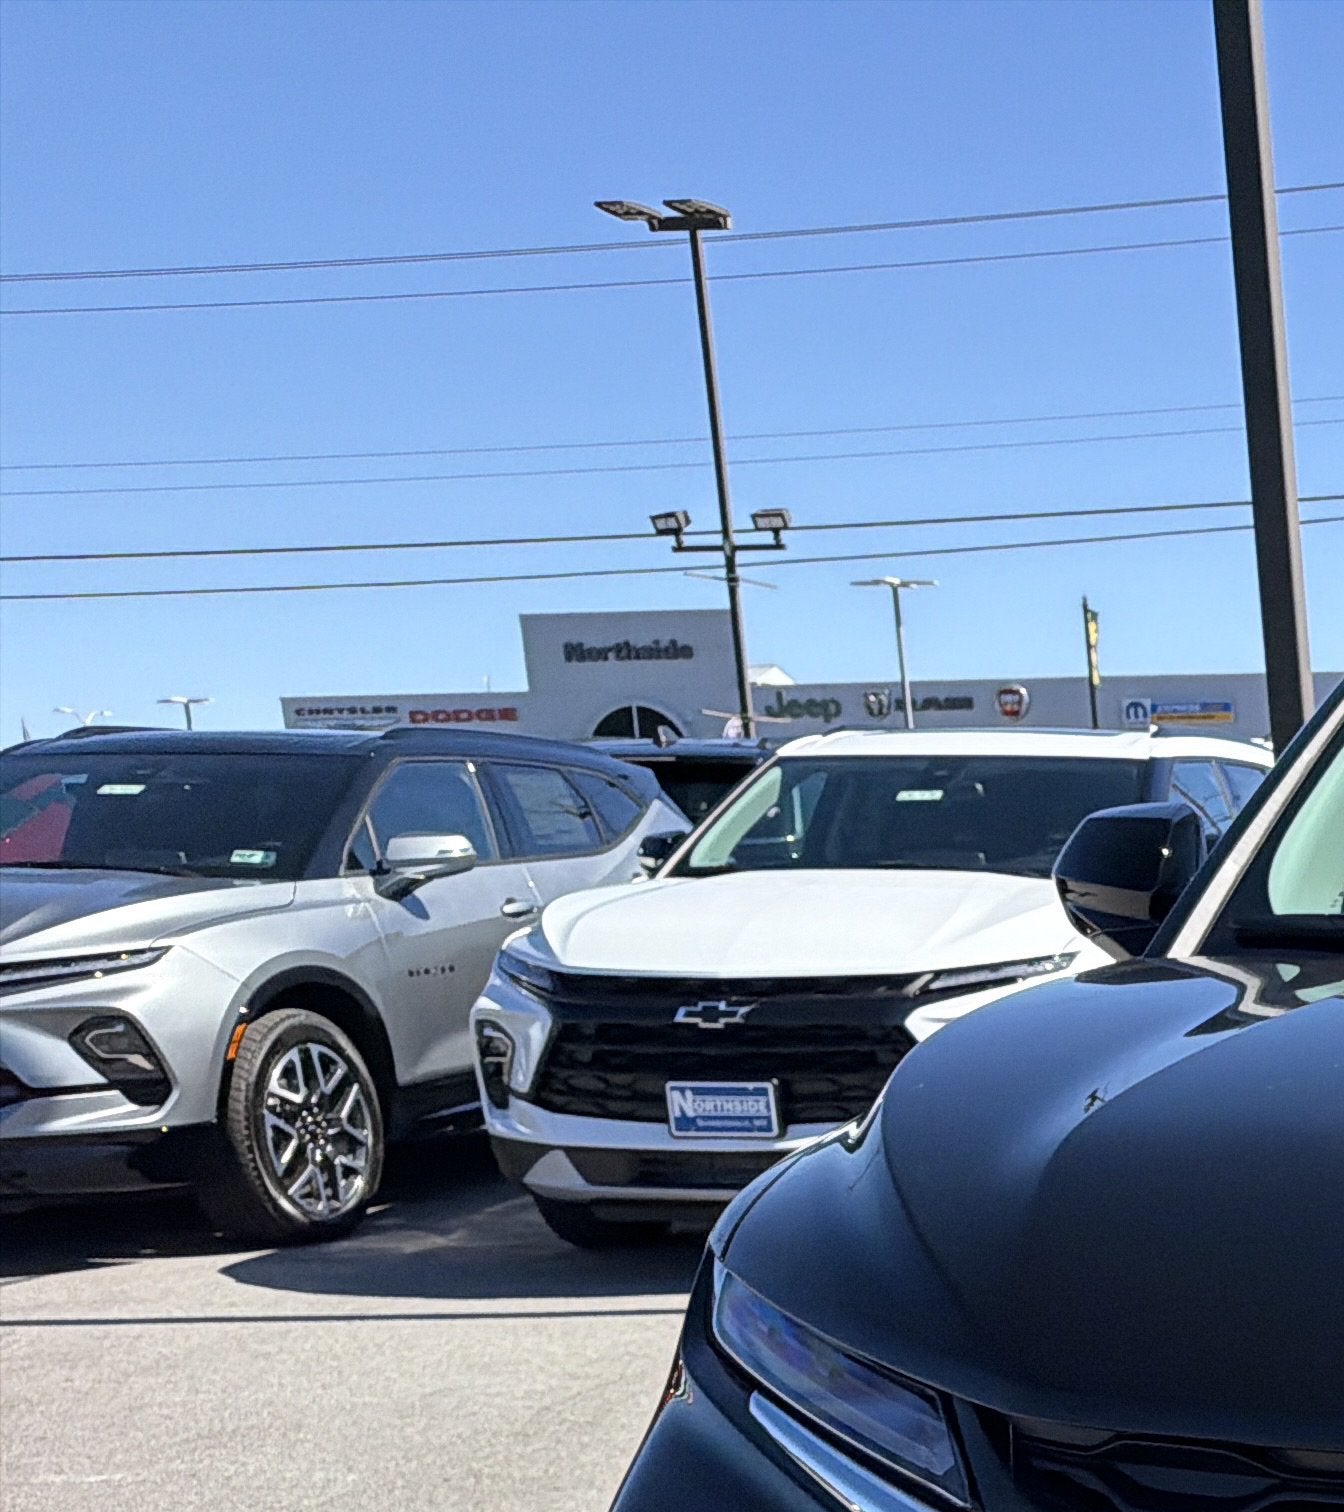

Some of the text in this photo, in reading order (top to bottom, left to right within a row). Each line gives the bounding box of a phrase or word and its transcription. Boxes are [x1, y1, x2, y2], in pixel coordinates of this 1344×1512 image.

[563, 639, 694, 662] Northside
[294, 705, 398, 717] CHRYSLER
[409, 707, 518, 723] DODGE
[765, 690, 842, 723] Jeep
[671, 1089, 767, 1118] NORTHSIDE
